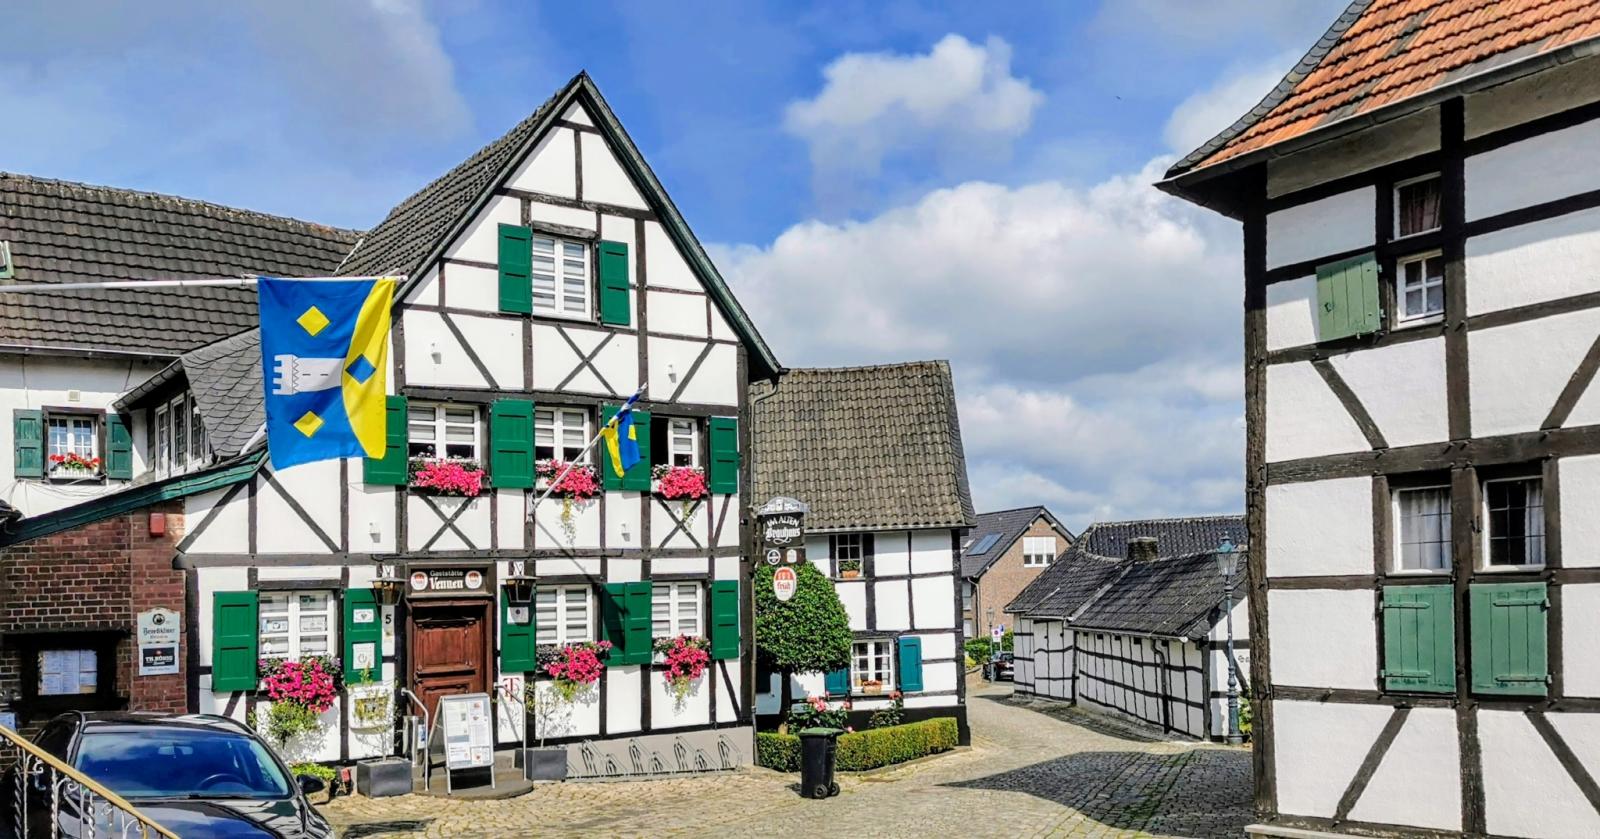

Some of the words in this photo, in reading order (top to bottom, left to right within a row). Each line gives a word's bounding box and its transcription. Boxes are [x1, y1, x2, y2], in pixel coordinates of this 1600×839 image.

[766, 517, 778, 528] IM
[779, 515, 800, 528] ALTEN
[765, 526, 801, 542] Brauhaus
[429, 577, 464, 590] Vennen
[385, 613, 392, 625] 5
